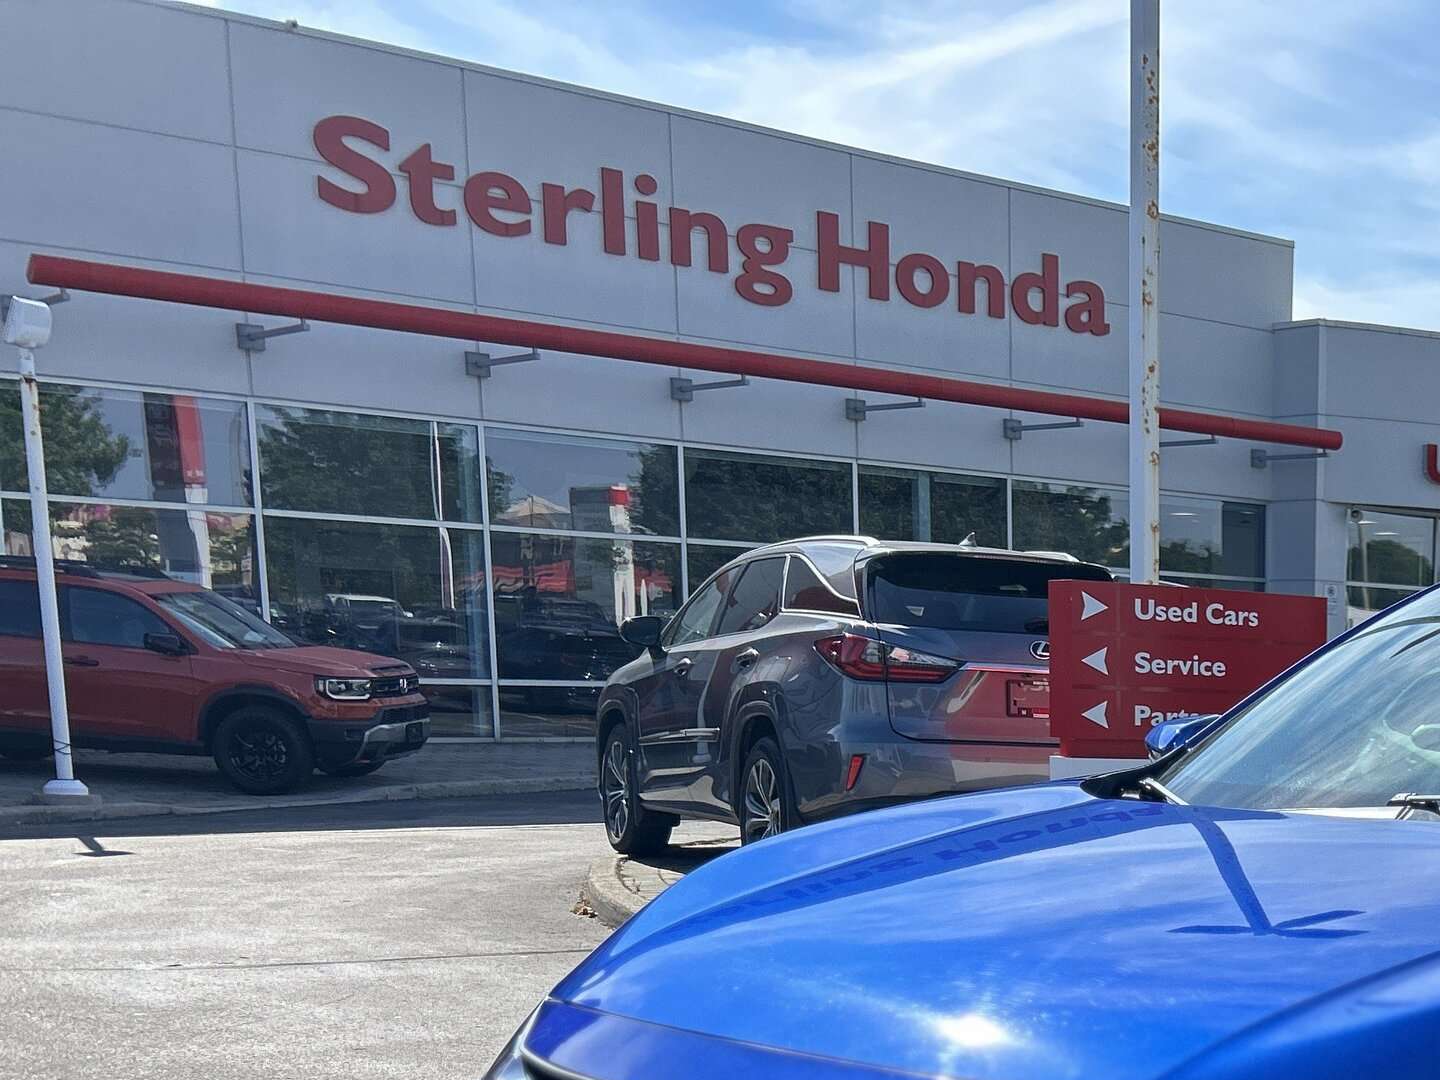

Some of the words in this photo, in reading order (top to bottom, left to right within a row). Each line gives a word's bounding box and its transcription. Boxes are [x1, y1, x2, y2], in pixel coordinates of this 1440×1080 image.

[312, 114, 796, 308] Sterling
[816, 209, 1111, 338] Honda
[1134, 598, 1198, 623] Used
[1206, 603, 1259, 627] Cars
[1134, 652, 1226, 677] Service
[1134, 705, 1200, 727] Par
